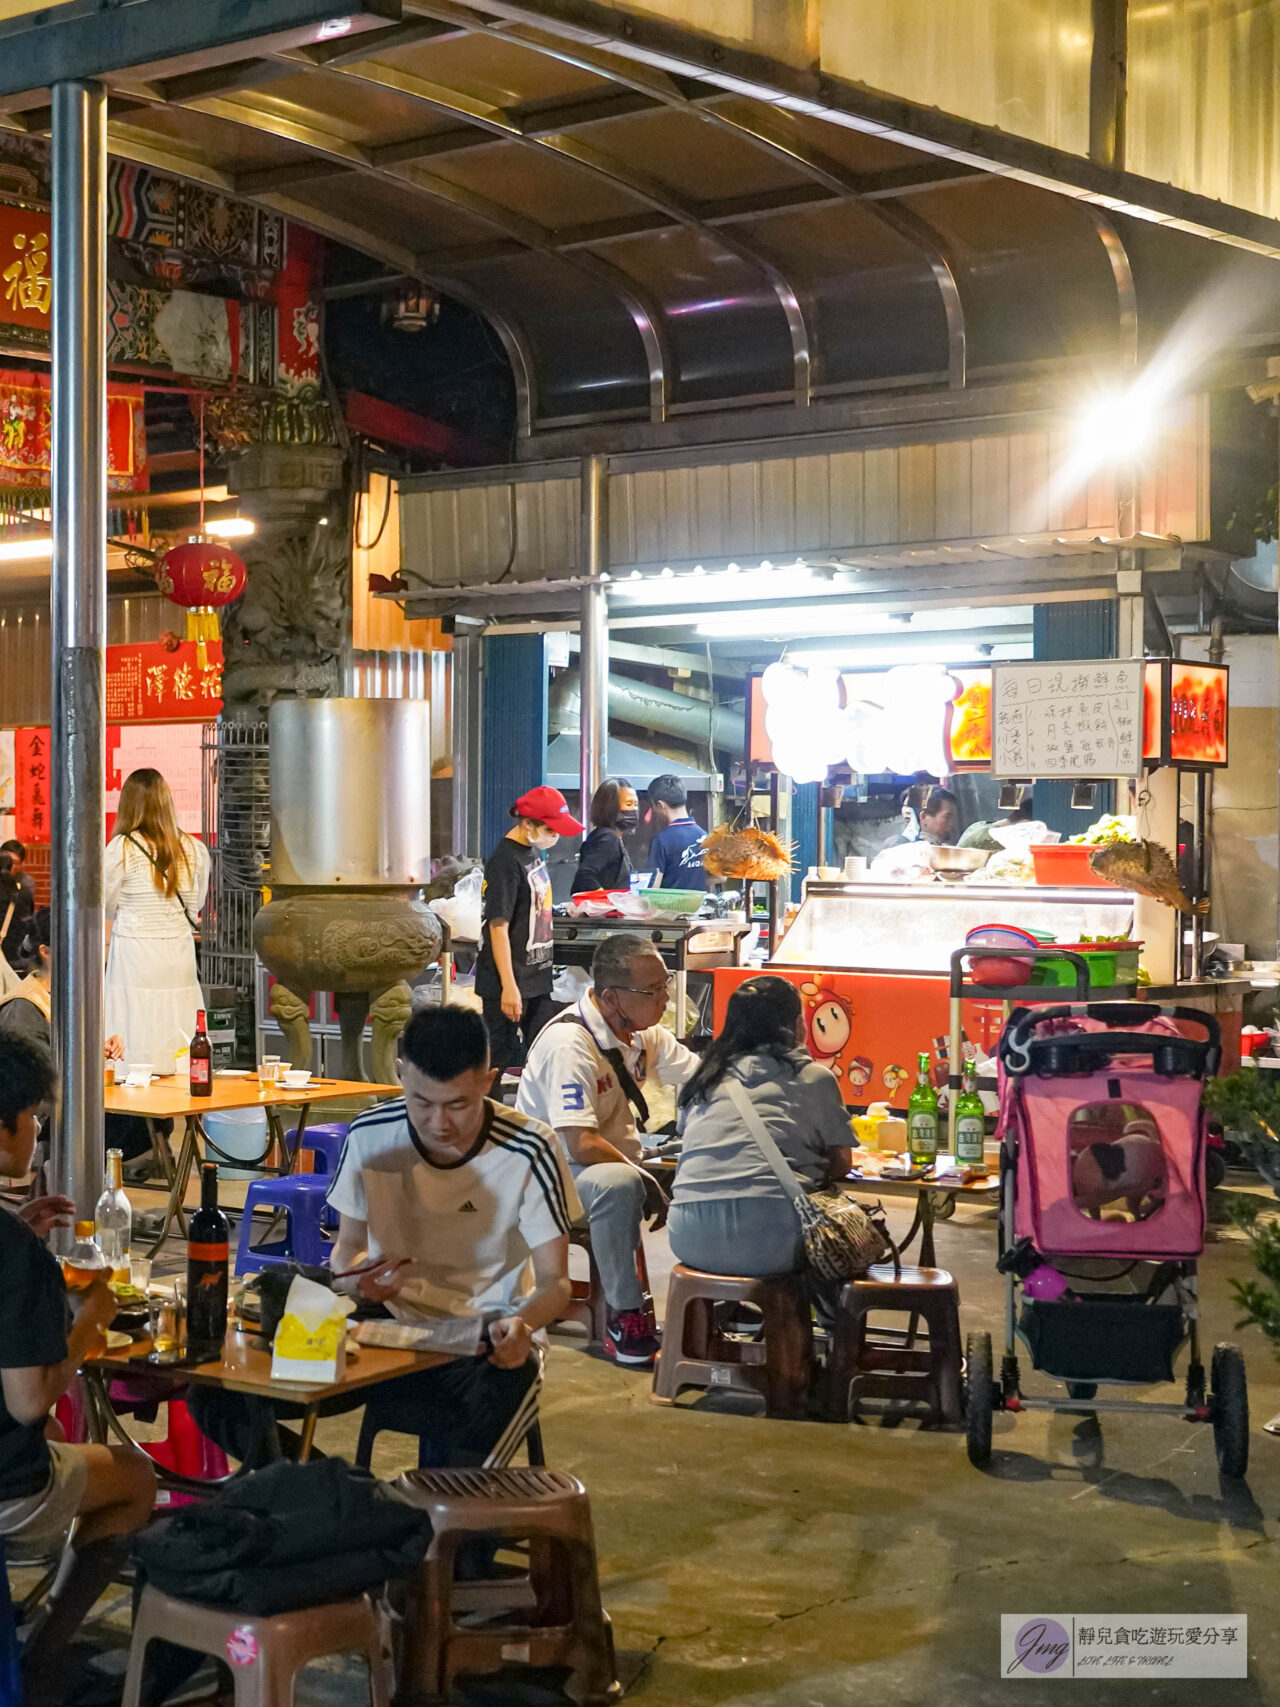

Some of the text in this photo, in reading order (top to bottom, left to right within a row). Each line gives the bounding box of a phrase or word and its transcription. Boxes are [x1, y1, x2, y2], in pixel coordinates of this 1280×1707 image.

[202, 557, 237, 593] 福
[1001, 670, 1129, 699] 每日現撈鮮魚
[561, 1083, 585, 1111] 3
